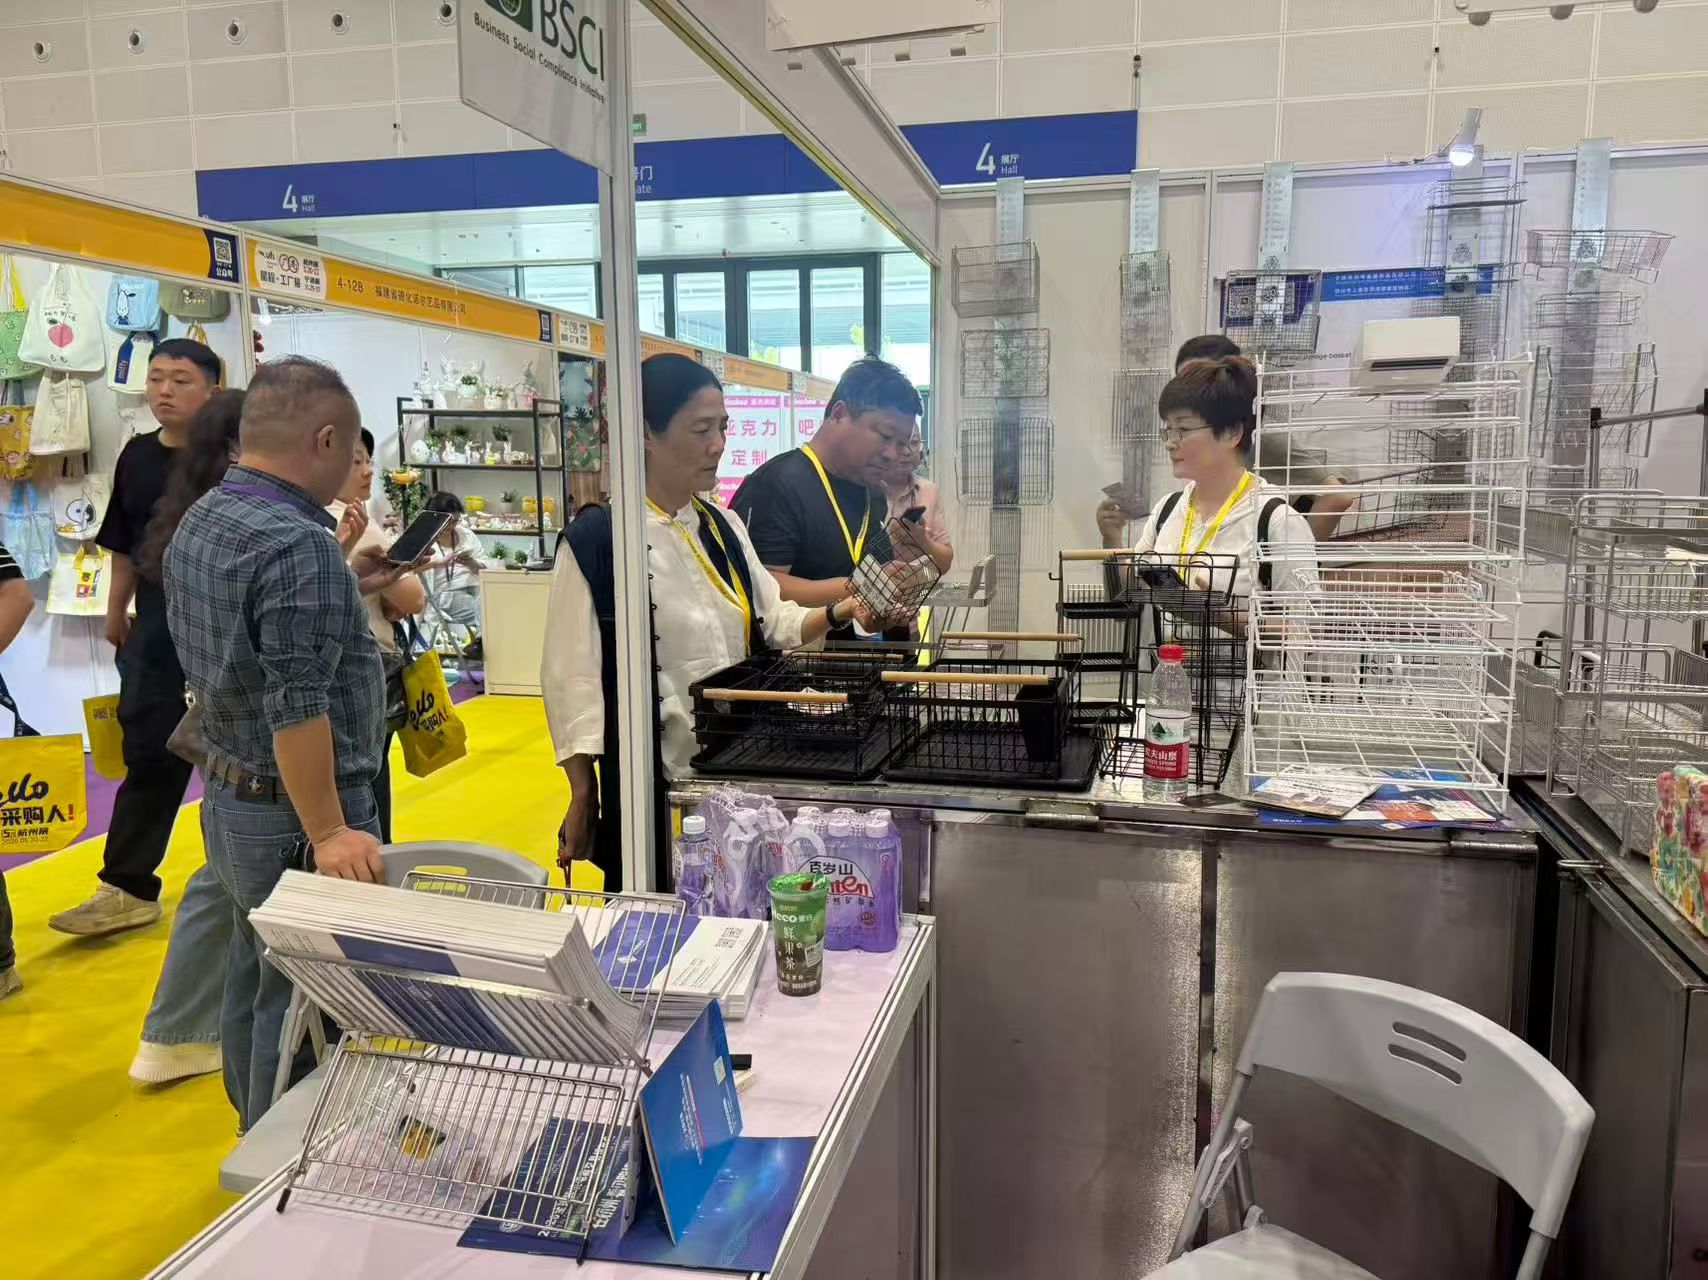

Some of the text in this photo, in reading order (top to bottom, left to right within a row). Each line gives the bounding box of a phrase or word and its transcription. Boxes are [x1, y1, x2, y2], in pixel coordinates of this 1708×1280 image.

[540, 0, 605, 81] BSCI
[474, 12, 510, 45] Business
[513, 36, 536, 60] Social
[538, 53, 578, 87] Compliance
[976, 142, 997, 175] 4
[1001, 154, 1020, 165] 展厅
[1001, 165, 1018, 174] Hall
[636, 184, 652, 194] ate
[282, 184, 298, 213] 4
[337, 277, 364, 293] 4-128
[1328, 352, 1352, 360] basket
[731, 449, 768, 467] 定制
[0, 803, 74, 826] 采购人!
[809, 861, 853, 875] 百岁山
